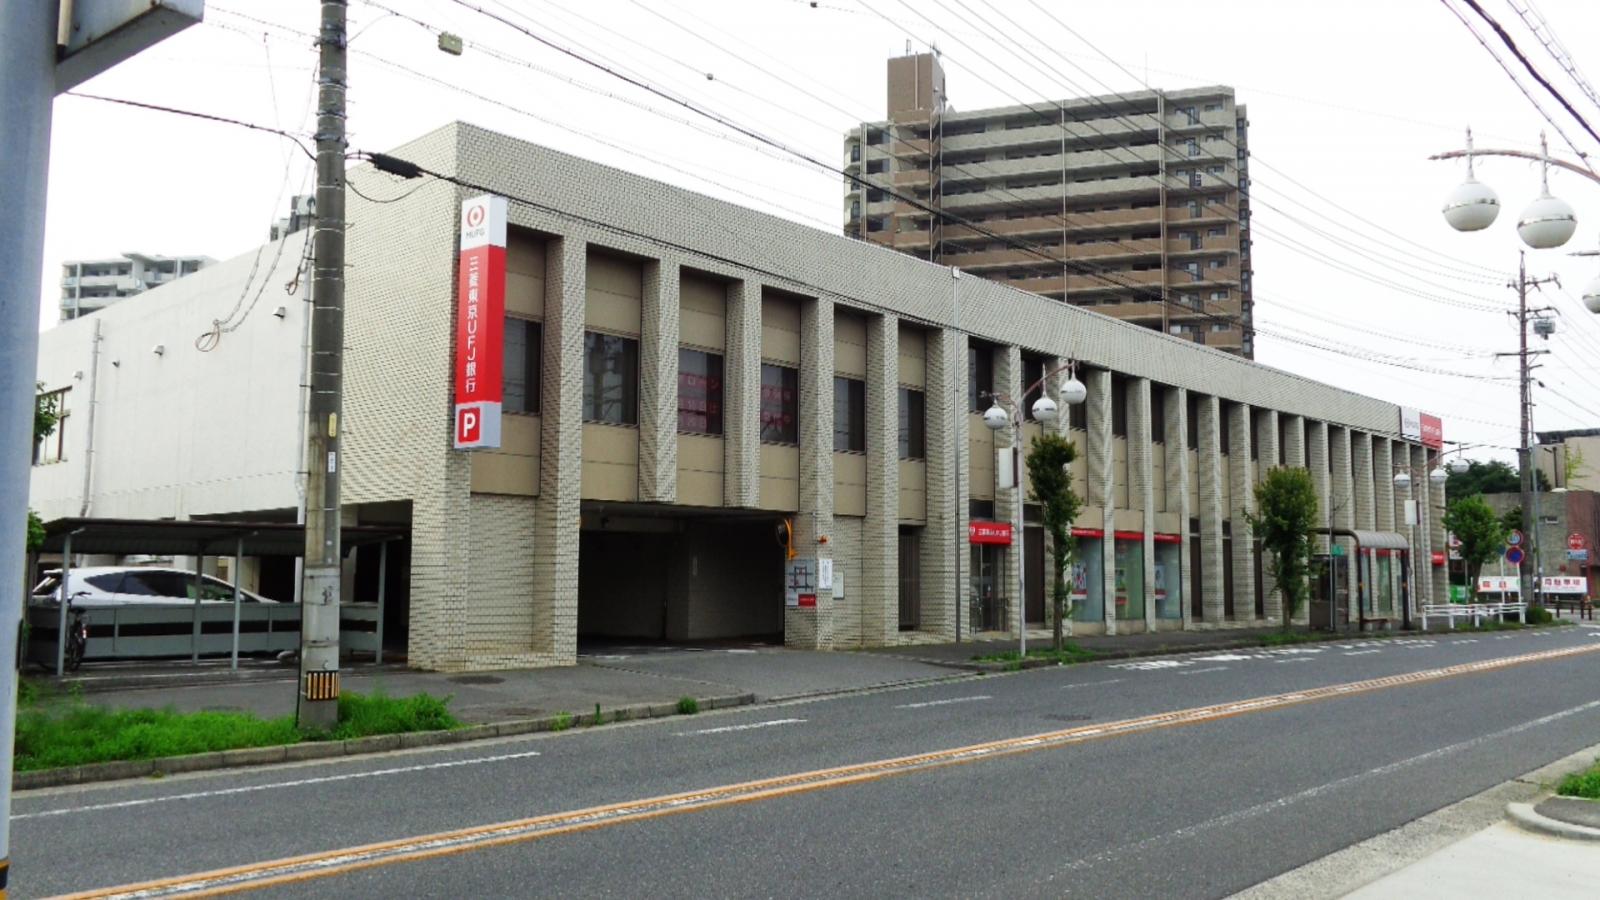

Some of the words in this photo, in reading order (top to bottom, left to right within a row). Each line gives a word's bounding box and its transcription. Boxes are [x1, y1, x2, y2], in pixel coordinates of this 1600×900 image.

[465, 228, 486, 239] MUFG
[465, 255, 480, 394] 三菱東京UFJ銀行
[462, 411, 477, 439] P
